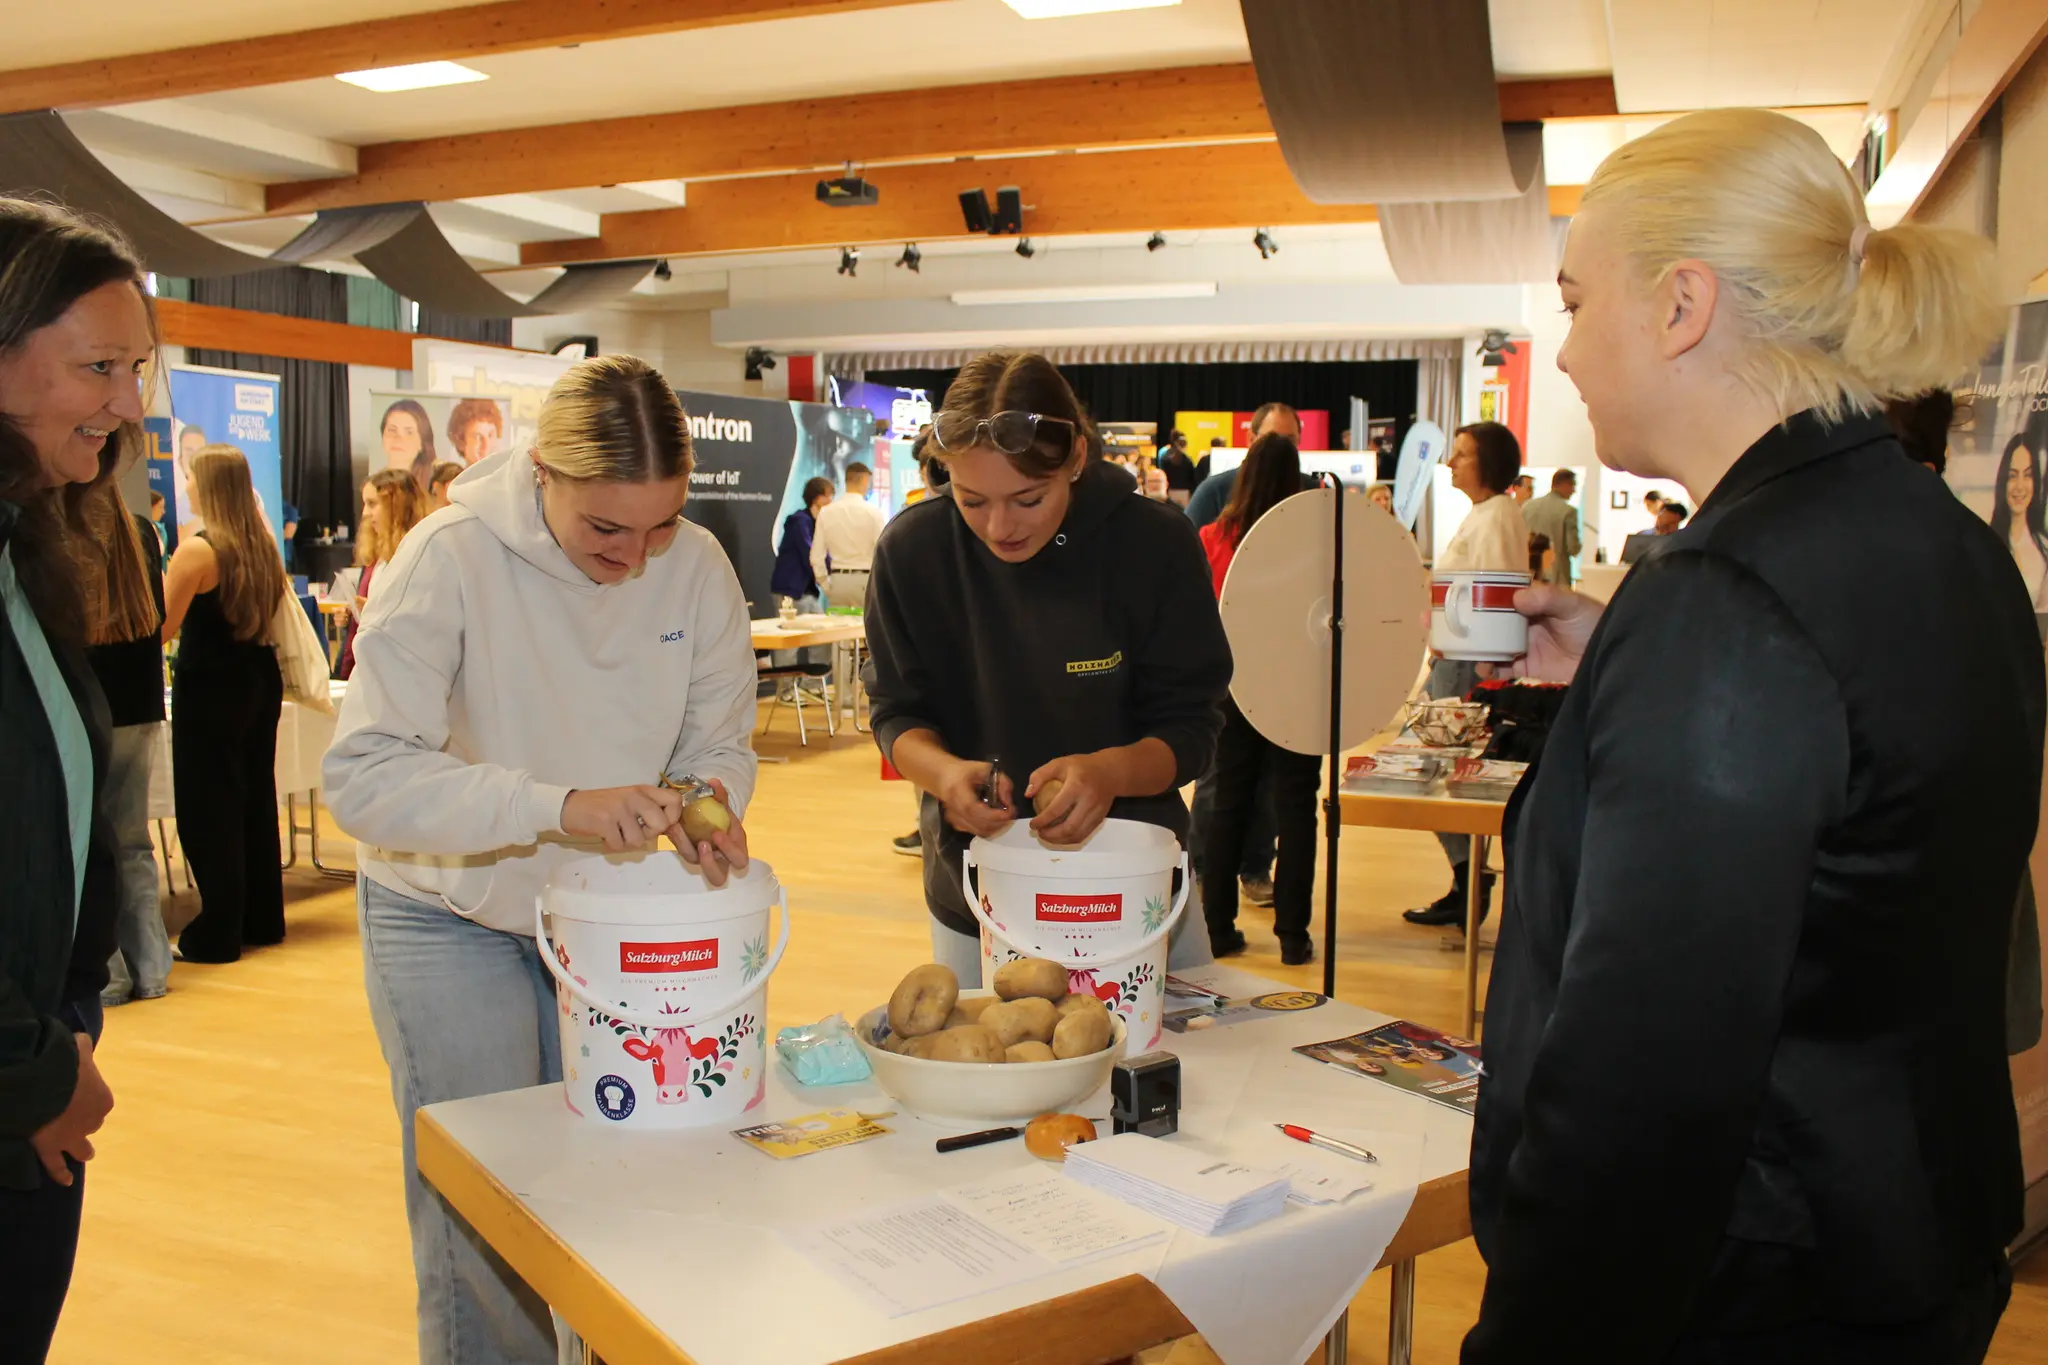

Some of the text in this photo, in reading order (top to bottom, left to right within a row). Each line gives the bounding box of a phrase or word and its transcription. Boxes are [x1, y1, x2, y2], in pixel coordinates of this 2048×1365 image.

[716, 469, 726, 485] of
[1040, 902, 1117, 917] SalzburgMilch
[625, 948, 713, 966] SalzburgMilch
[599, 1076, 629, 1090] PREMIUM
[596, 1093, 635, 1119] HAUBENKLASSE
